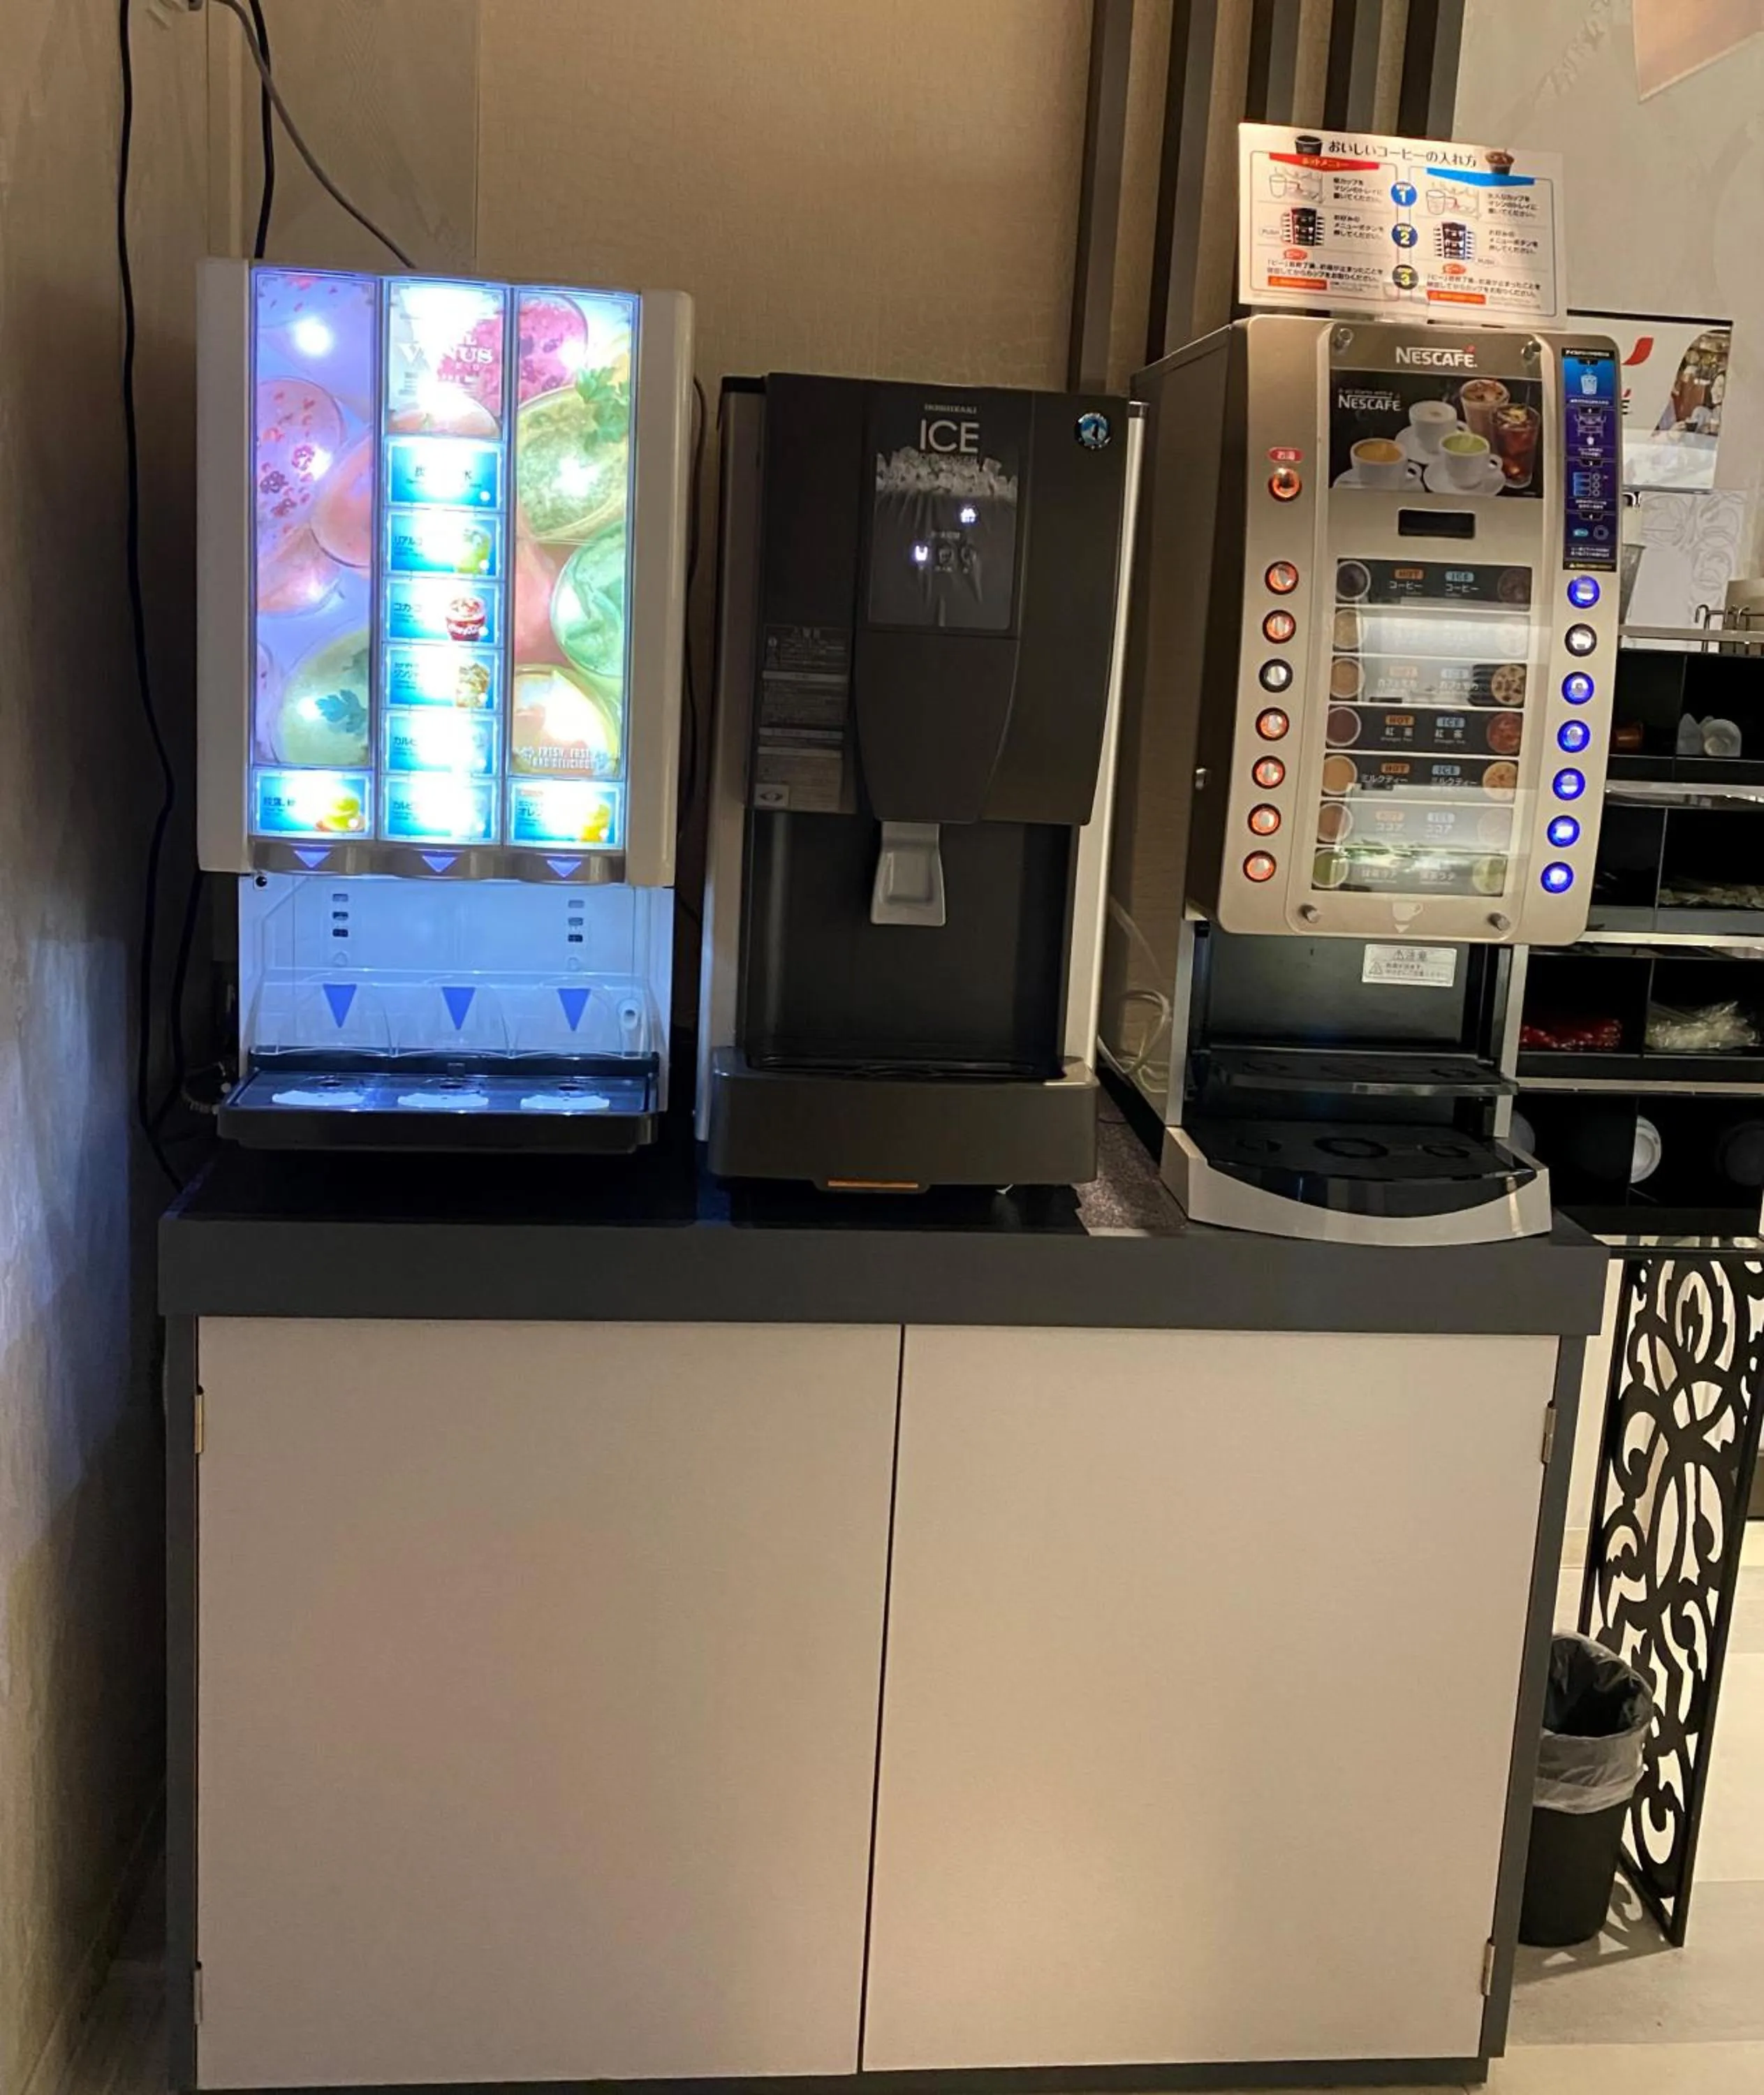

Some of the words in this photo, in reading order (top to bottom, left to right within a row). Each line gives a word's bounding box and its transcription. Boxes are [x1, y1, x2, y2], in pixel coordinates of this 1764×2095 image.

[1328, 140, 1476, 168] おいしいコーヒーの入れ方
[1399, 191, 1406, 203] 1
[1400, 234, 1410, 244] 2
[1401, 272, 1410, 286] 3
[920, 419, 980, 453] ICE
[1389, 580, 1423, 589] コーヒー
[1445, 583, 1480, 593] コーヒー
[1389, 716, 1410, 724] HOT
[1443, 718, 1461, 726] ICE
[1386, 764, 1406, 772] HOT
[1362, 774, 1409, 784] ミルクティー
[1432, 777, 1478, 786] ミルクティー
